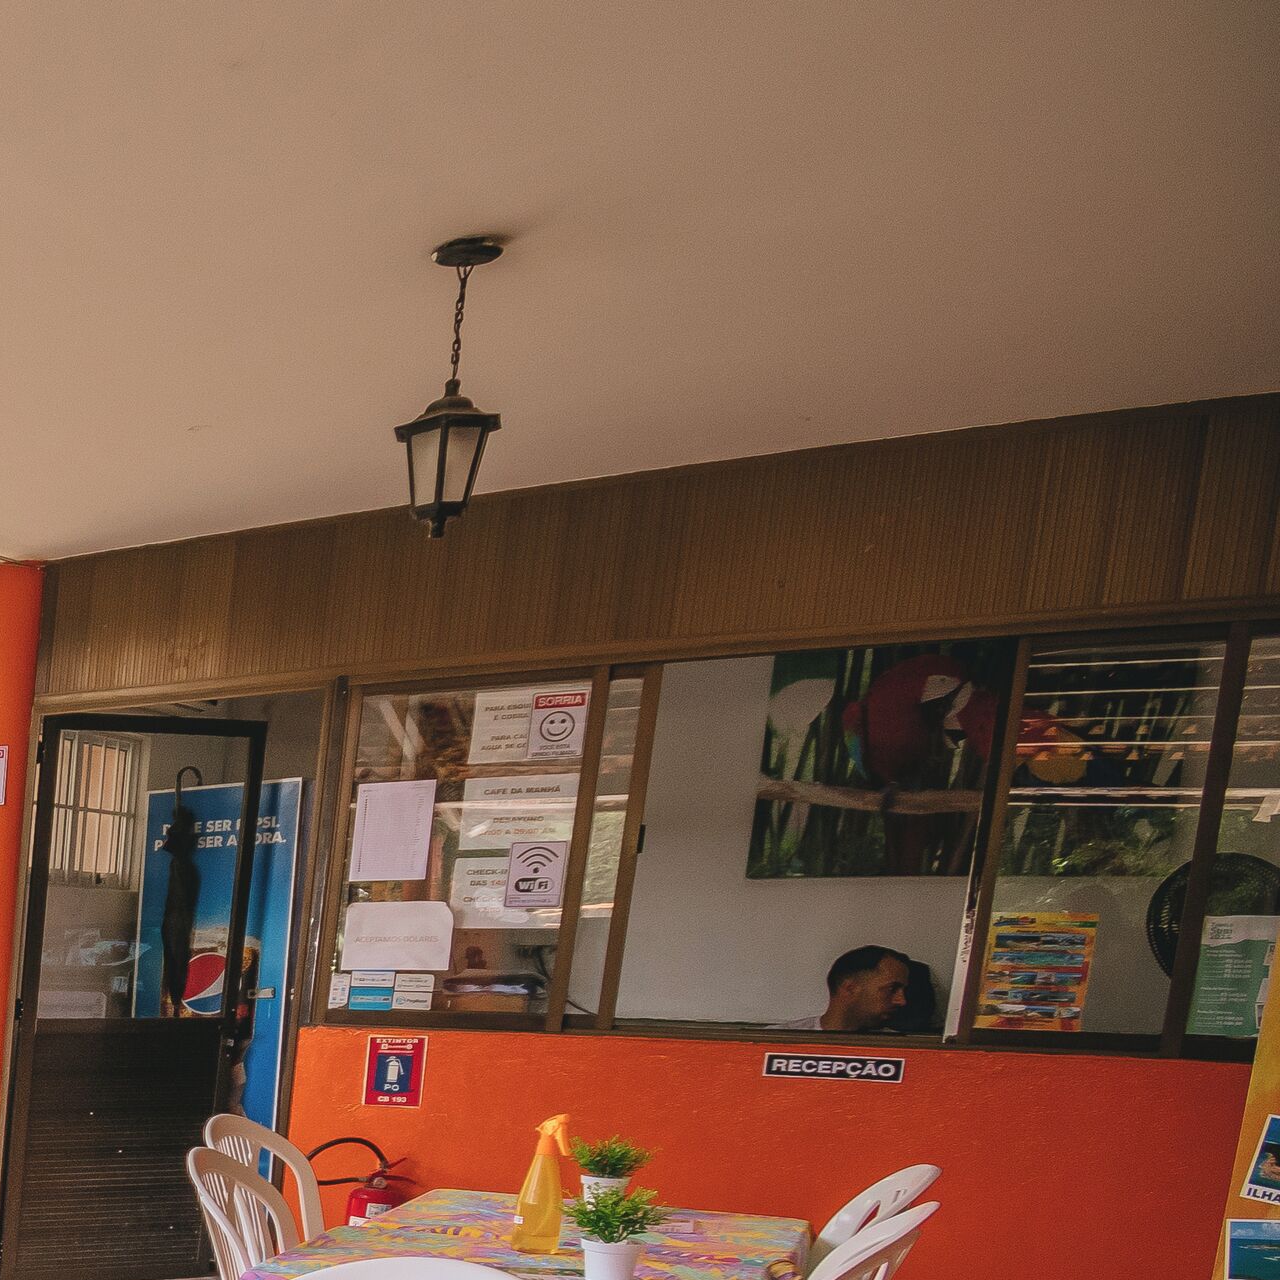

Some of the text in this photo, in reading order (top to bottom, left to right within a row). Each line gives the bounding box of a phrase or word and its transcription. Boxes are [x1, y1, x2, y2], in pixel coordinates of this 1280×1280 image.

[538, 695, 583, 707] SORRIA
[162, 816, 280, 835] PE SER PSI.
[197, 835, 223, 849] SER
[771, 1058, 896, 1078] RECEPÇÃO
